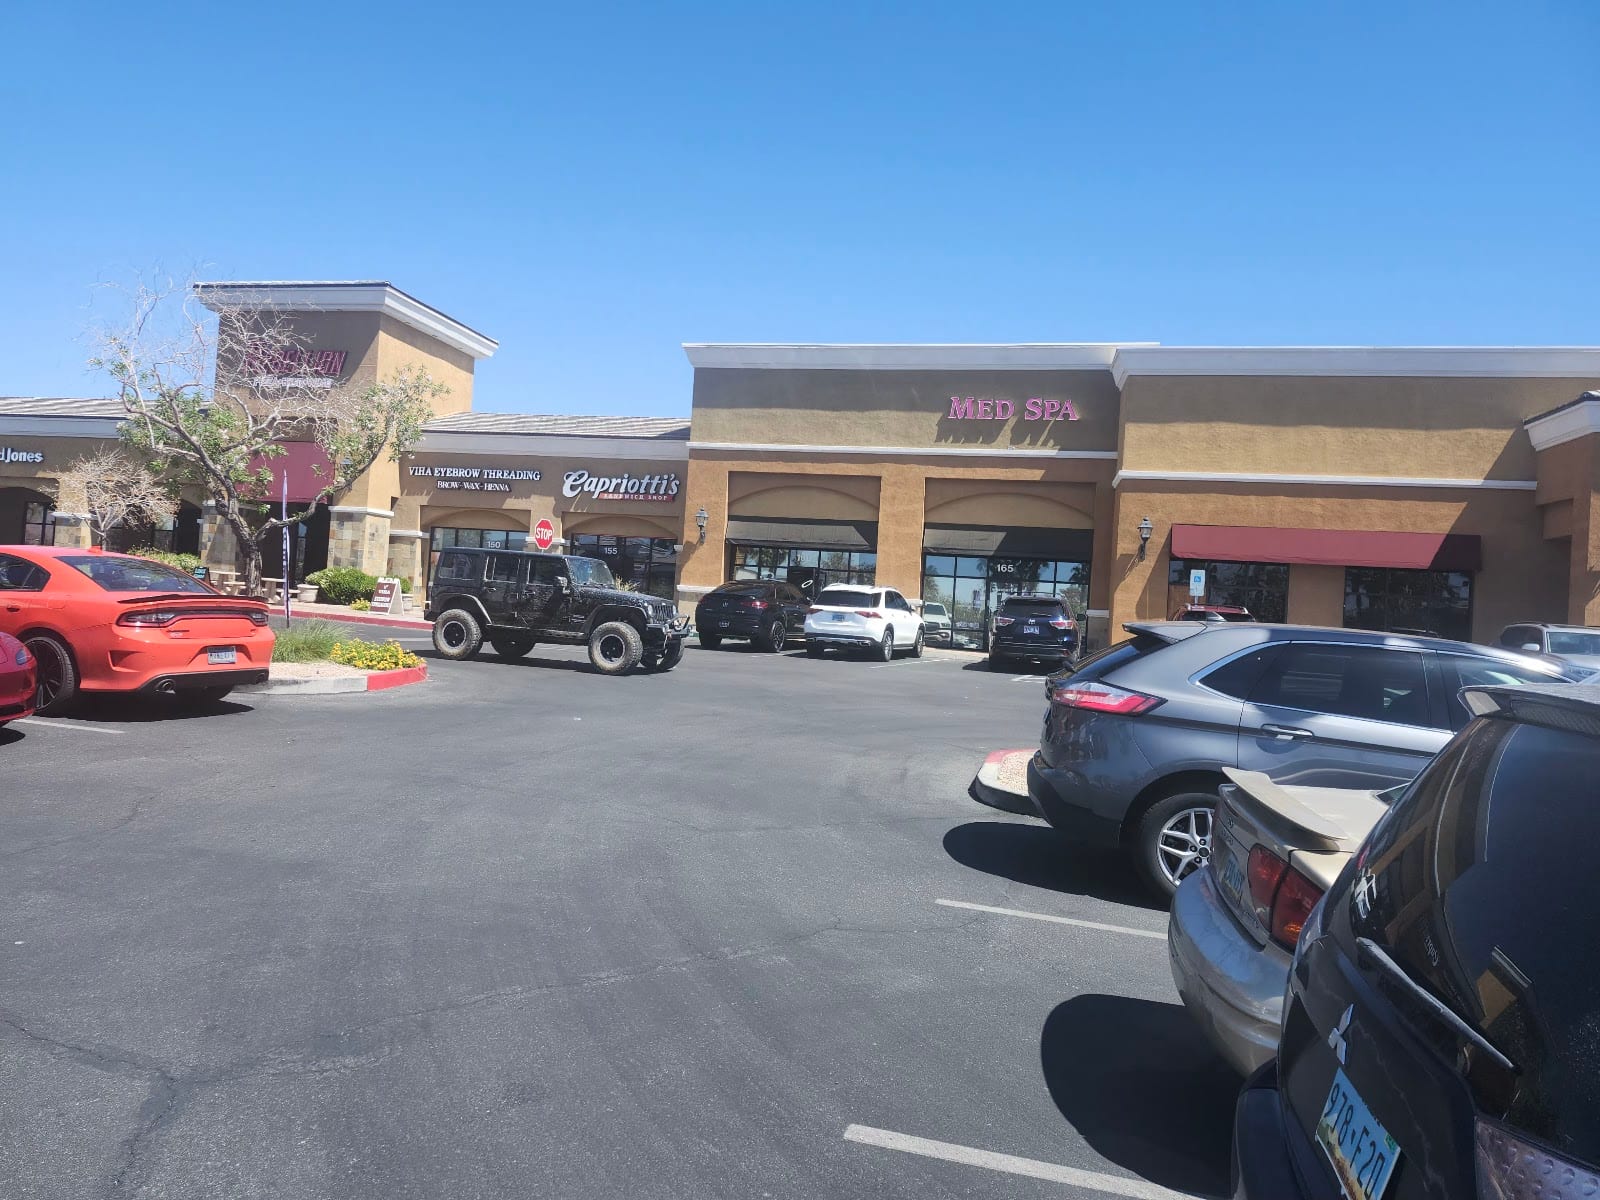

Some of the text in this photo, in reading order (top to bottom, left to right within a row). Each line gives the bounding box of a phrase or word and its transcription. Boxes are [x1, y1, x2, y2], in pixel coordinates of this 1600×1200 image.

[947, 396, 1080, 421] MED SPA
[408, 466, 541, 481] VIHA EYEBROW THREADING
[562, 470, 680, 498] Capriotti's
[535, 527, 553, 540] STOP
[488, 541, 501, 549] 150
[605, 547, 618, 555] 155
[997, 564, 1014, 573] 165
